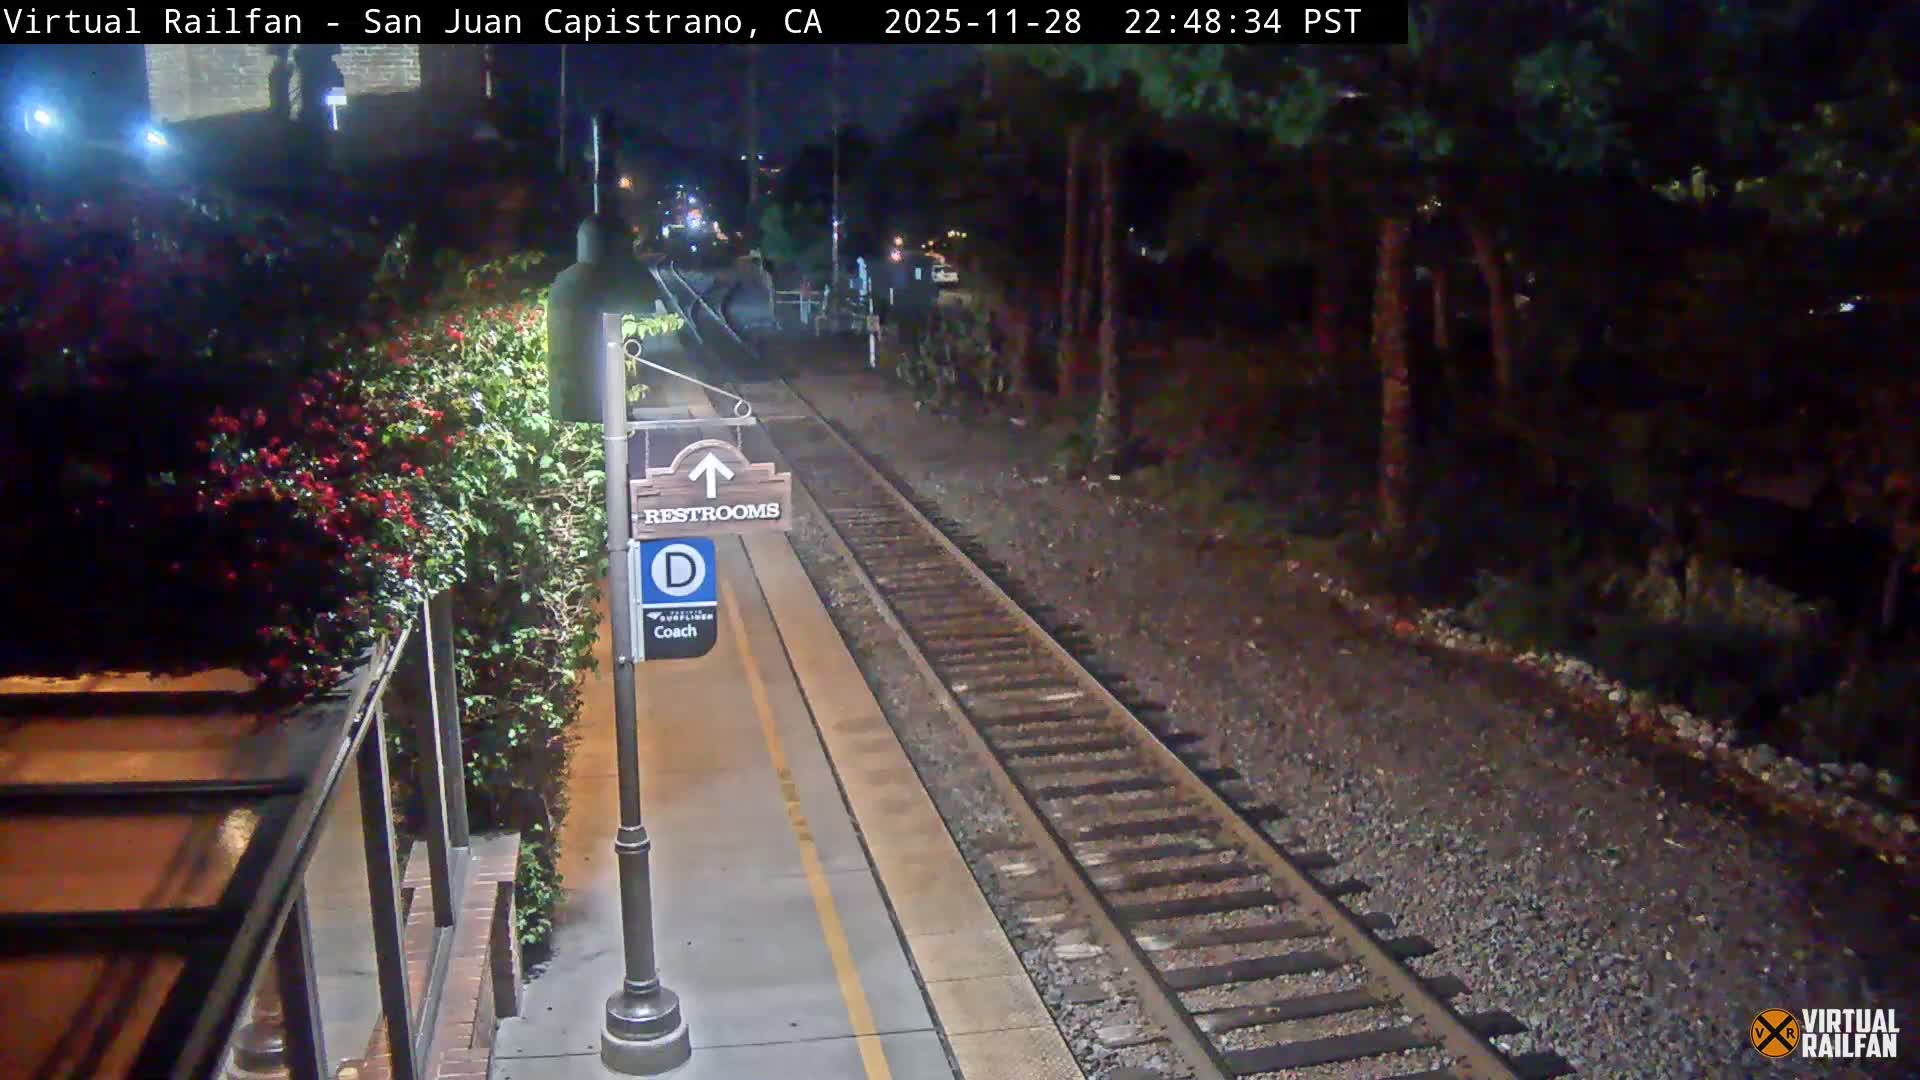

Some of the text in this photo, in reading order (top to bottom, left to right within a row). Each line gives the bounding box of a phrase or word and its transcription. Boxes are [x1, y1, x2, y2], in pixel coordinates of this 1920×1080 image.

[644, 503, 780, 524] RESTROOMS
[665, 552, 696, 588] D
[654, 623, 697, 639] Coach
